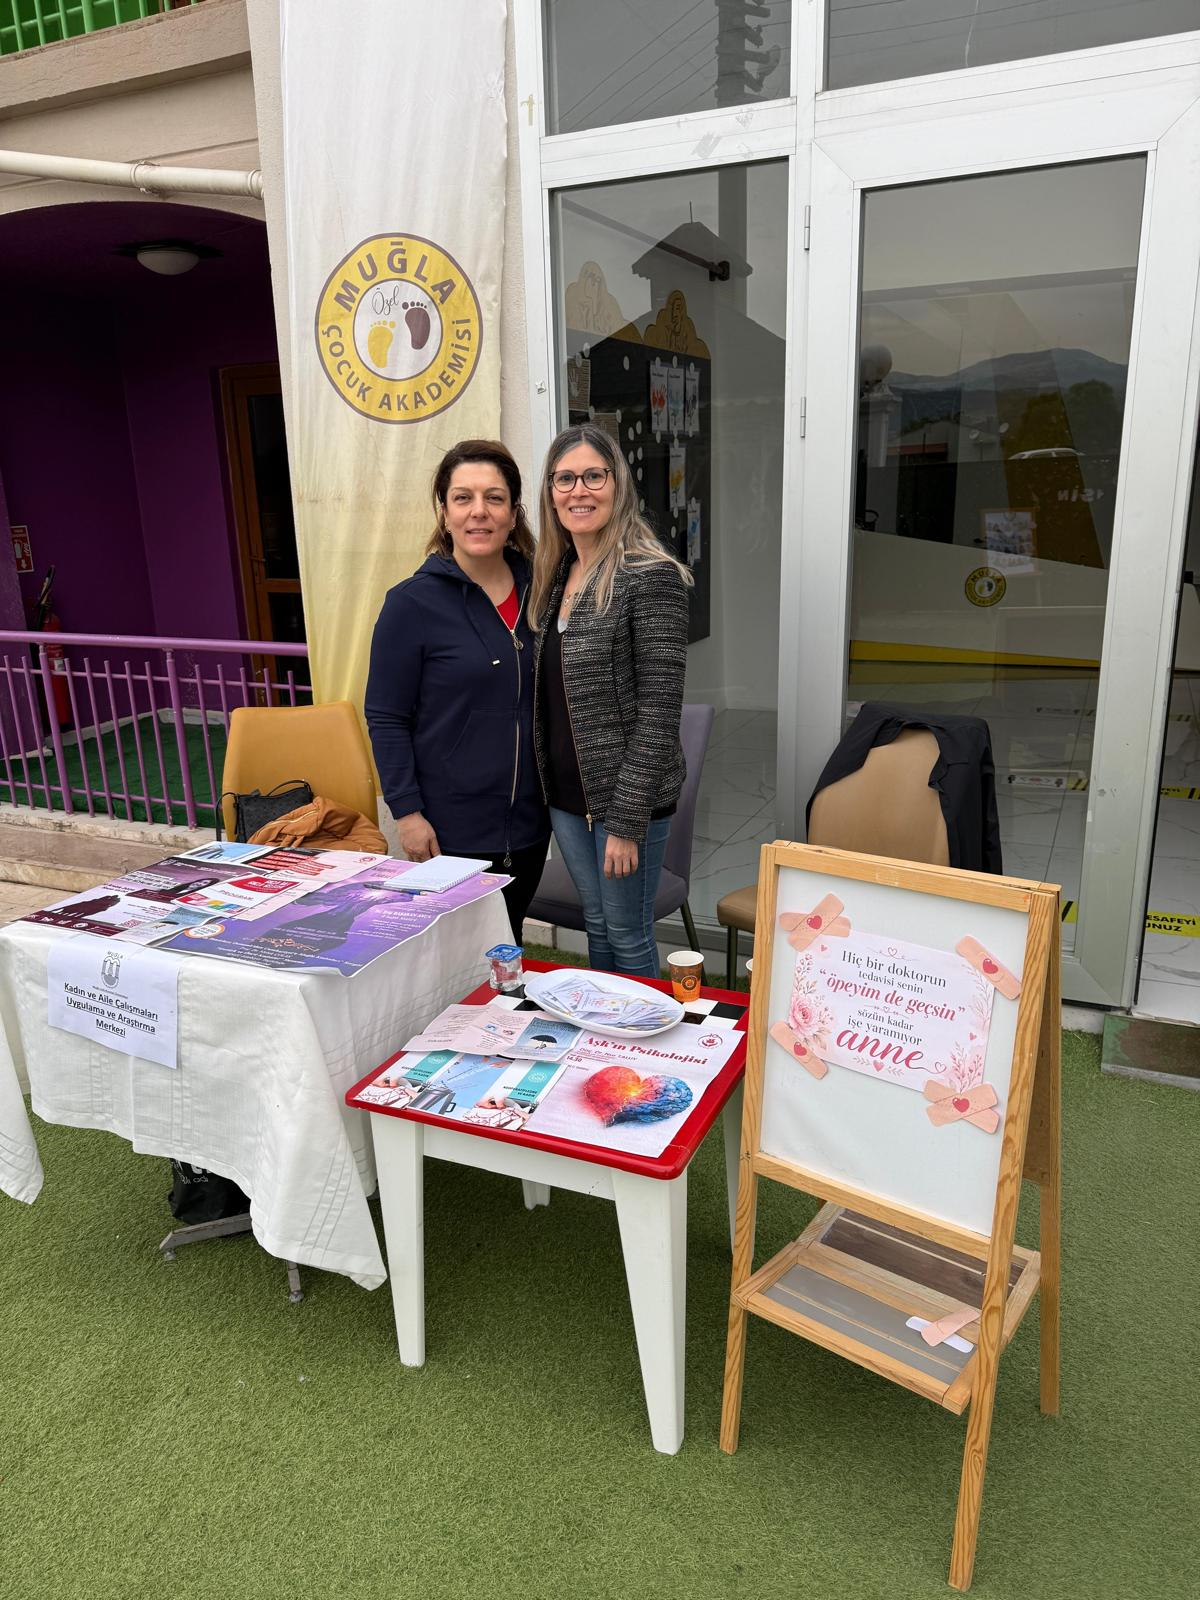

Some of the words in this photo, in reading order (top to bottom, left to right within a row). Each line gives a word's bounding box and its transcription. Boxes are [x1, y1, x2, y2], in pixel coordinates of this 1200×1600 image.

[334, 241, 457, 313] MUĞLA
[372, 285, 400, 316] Özel
[322, 324, 373, 402] ÇOCUK
[378, 318, 472, 412] AKADEMİSİ
[1145, 914, 1196, 926] ESAFEYİ
[841, 950, 864, 968] Hiç
[866, 955, 884, 972] bir
[887, 959, 947, 988] doktorun
[858, 970, 895, 988] tedavisi
[897, 981, 924, 995] senin
[64, 982, 86, 997] Kadın
[87, 991, 97, 1000] ve
[98, 994, 114, 1005] Aile
[115, 999, 158, 1021] Çalışmaları
[885, 989, 904, 1007] de
[66, 996, 105, 1016] Uygulama
[106, 1010, 116, 1019] ve
[117, 1013, 156, 1034] Araştırma
[96, 1018, 126, 1037] Merkezi
[857, 1008, 885, 1023] sözün
[887, 1015, 914, 1031] kadar
[847, 1016, 863, 1029] işe
[865, 1023, 923, 1046] yaramıyor
[630, 1045, 709, 1065] Psikolojisi
[836, 1029, 926, 1070] anne
